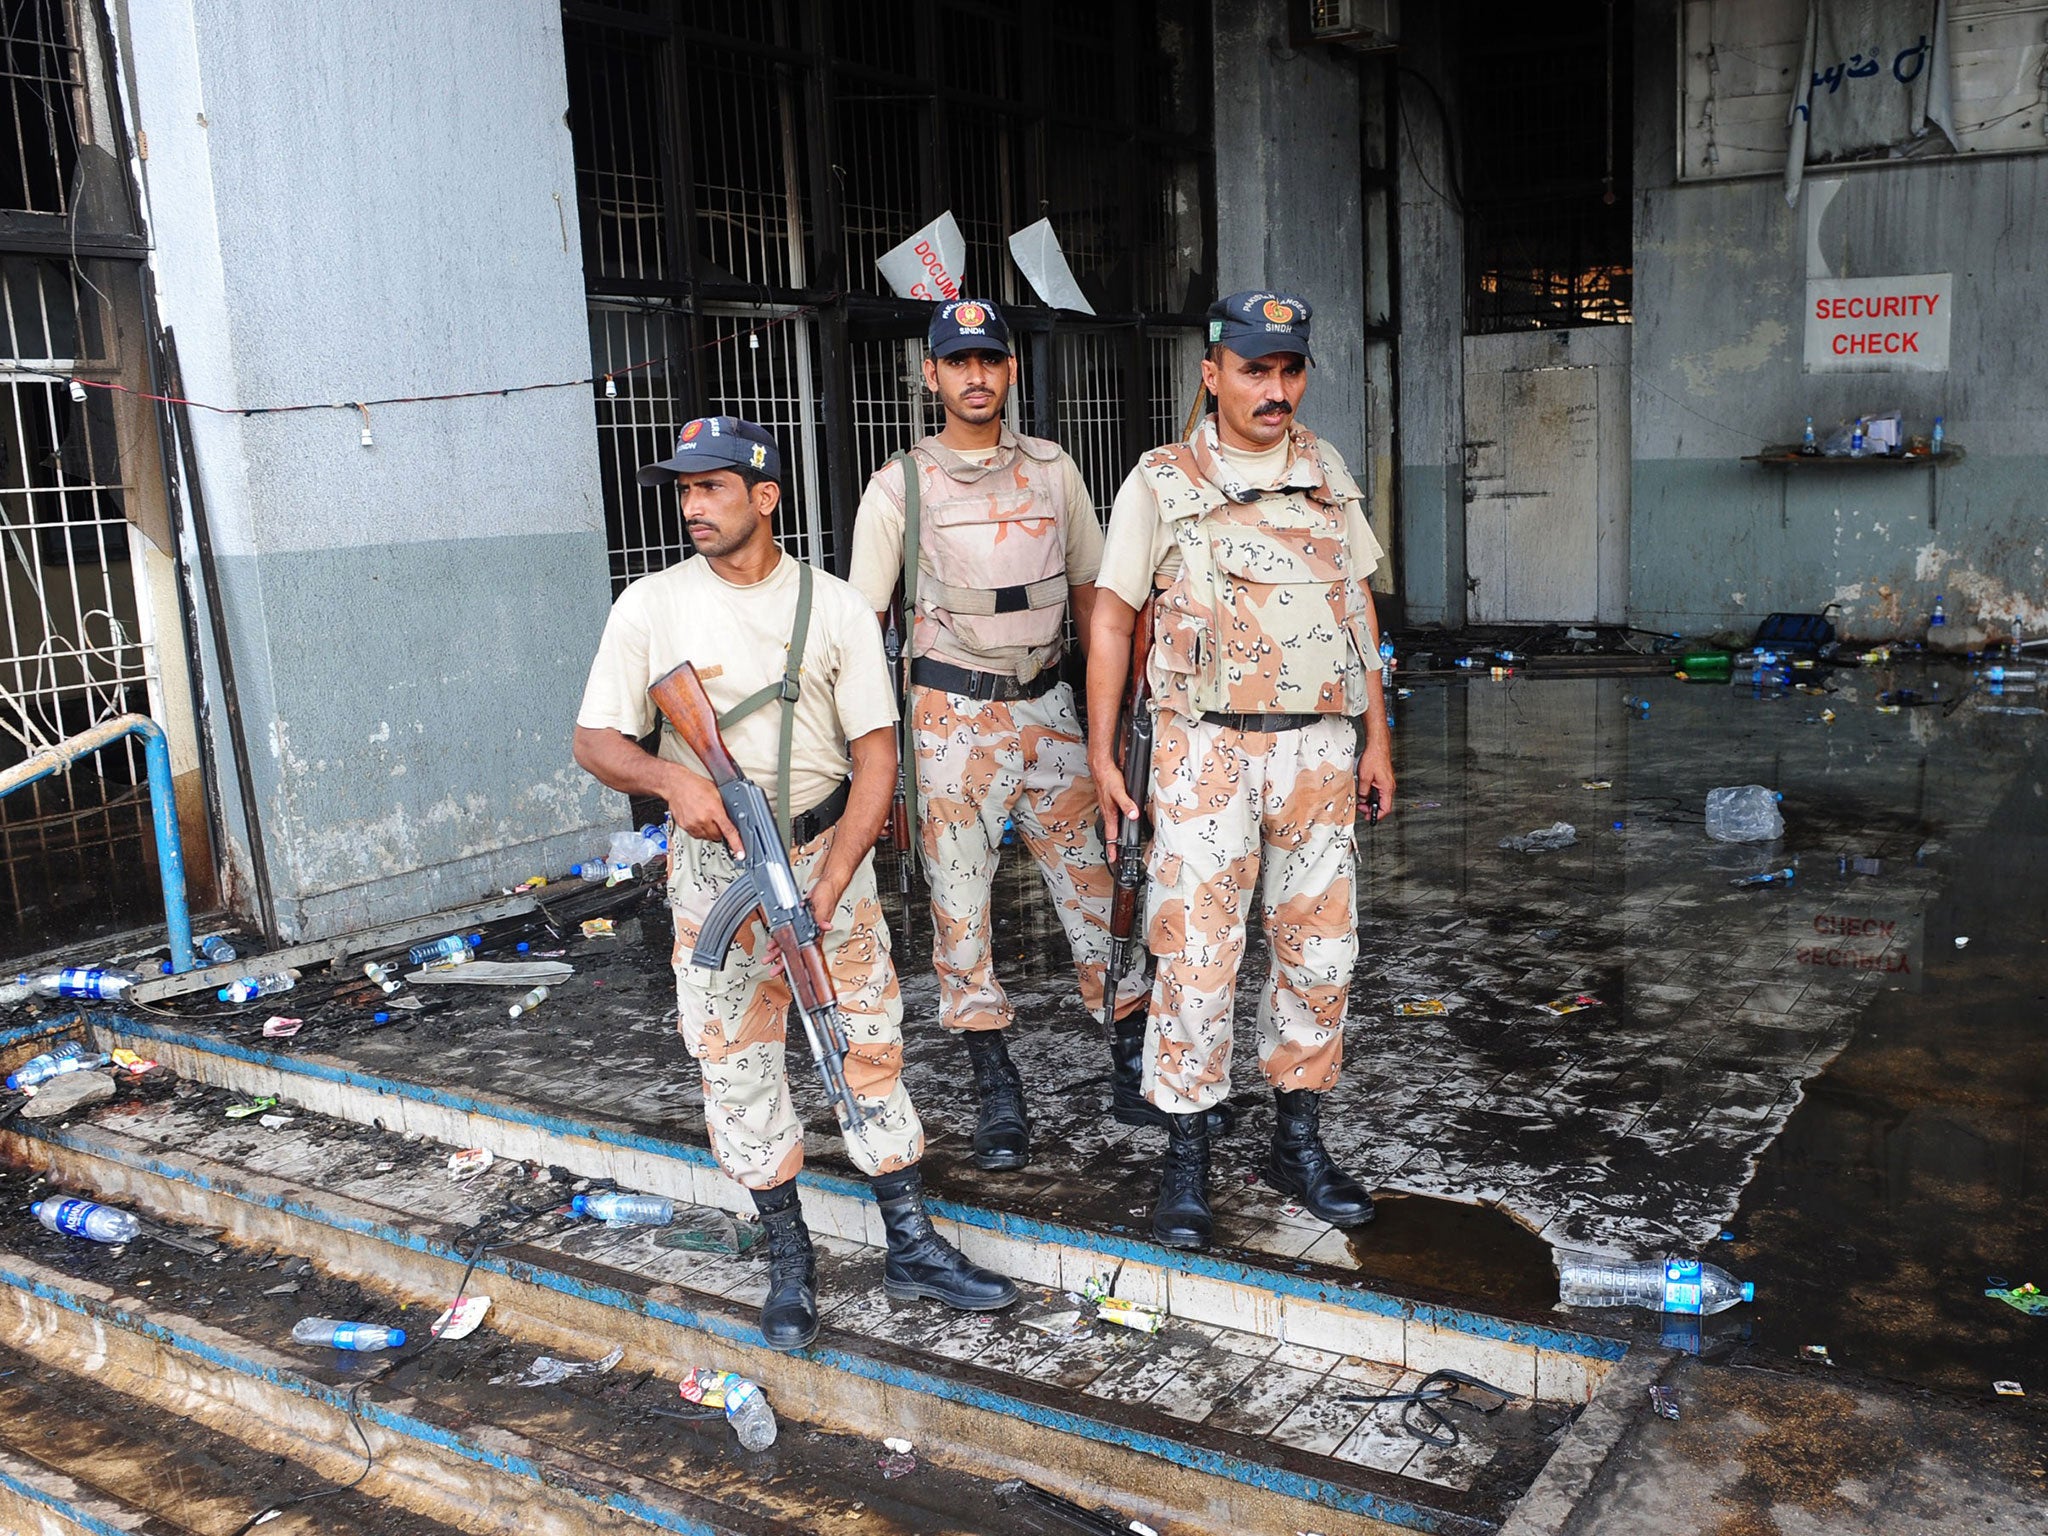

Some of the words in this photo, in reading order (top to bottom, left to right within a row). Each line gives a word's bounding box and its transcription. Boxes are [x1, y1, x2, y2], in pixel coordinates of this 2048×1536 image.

[1276, 297, 1308, 320] ANGERS
[1816, 294, 1940, 319] SECURITY
[959, 327, 986, 336] SINDH
[1265, 322, 1292, 333] SINDH
[1832, 332, 1919, 355] CHECK
